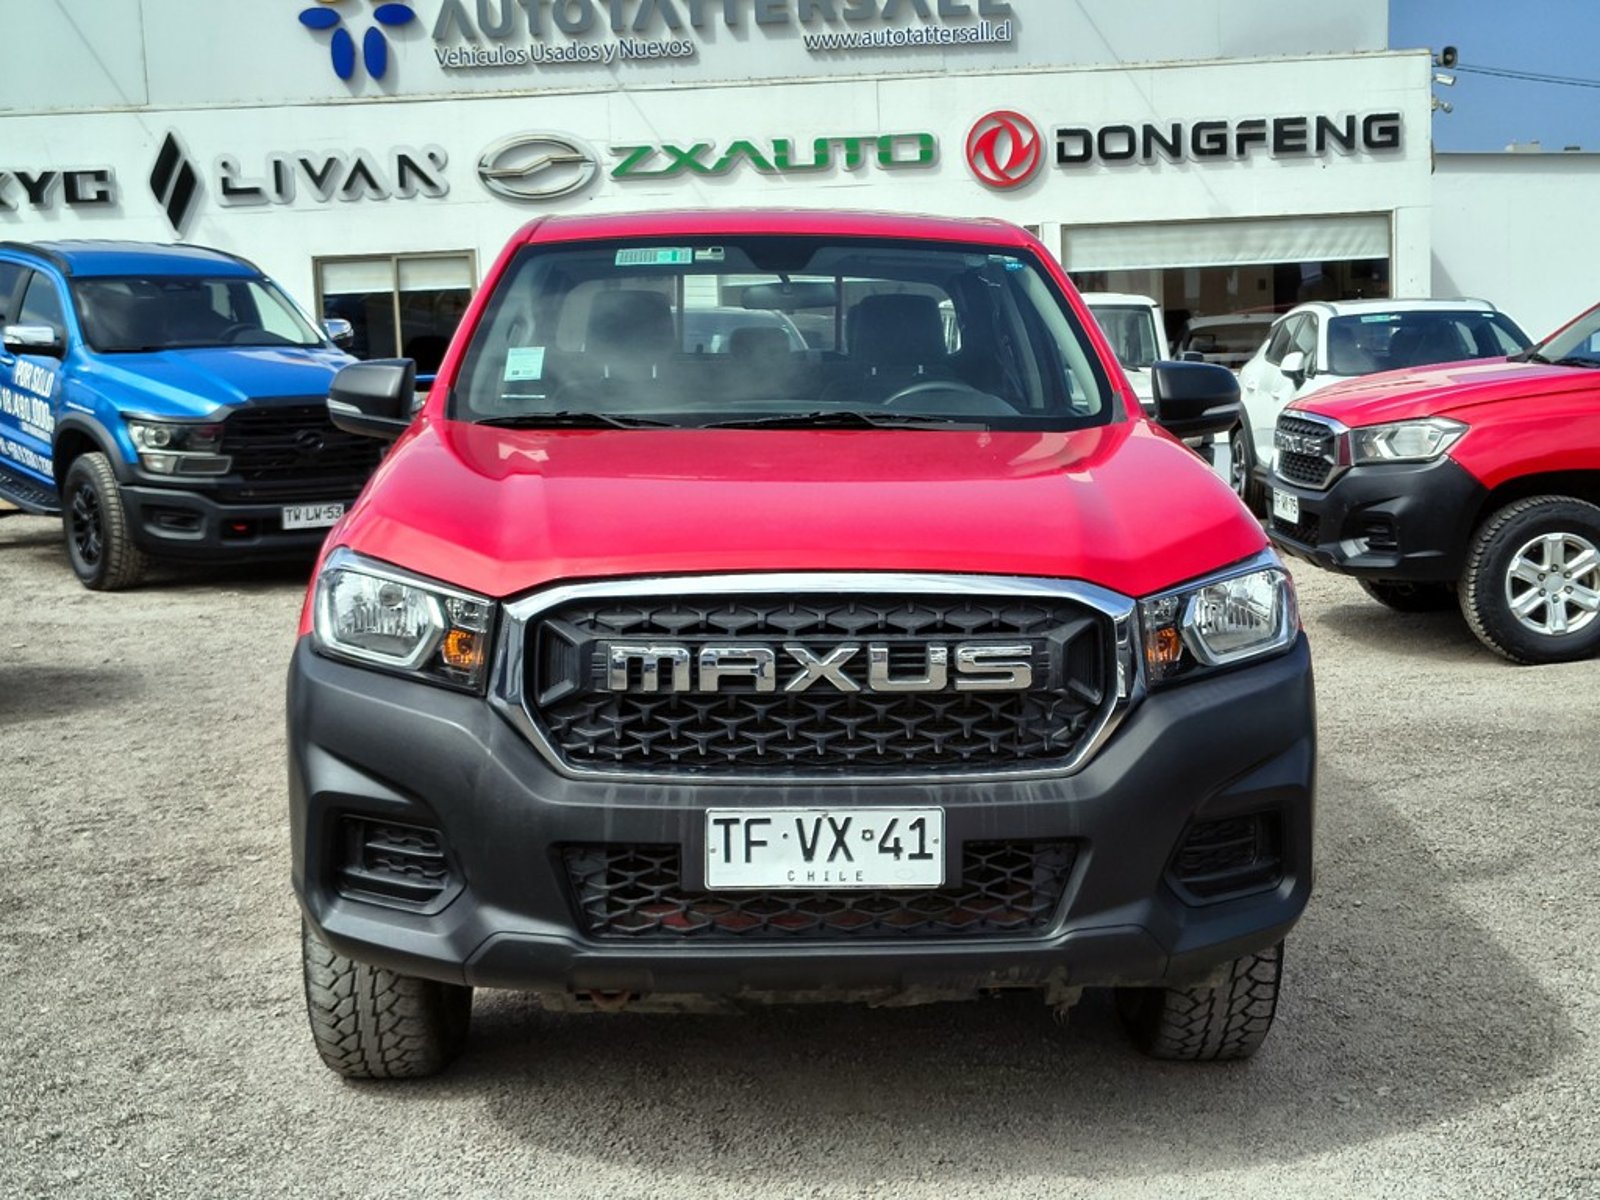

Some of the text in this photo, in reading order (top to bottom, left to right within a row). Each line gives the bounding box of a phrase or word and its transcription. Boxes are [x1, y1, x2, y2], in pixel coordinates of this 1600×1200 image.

[435, 39, 693, 67] Vehículos Usados y Nuevos
[803, 21, 1012, 49] www.autotattersall.cl
[610, 133, 935, 178] ZXAUTO
[1057, 112, 1401, 164] DONGFENG
[0, 170, 111, 204] YC
[221, 152, 439, 196] LIVAN
[608, 643, 1033, 692] MAXUS
[787, 870, 864, 882] CHILE
